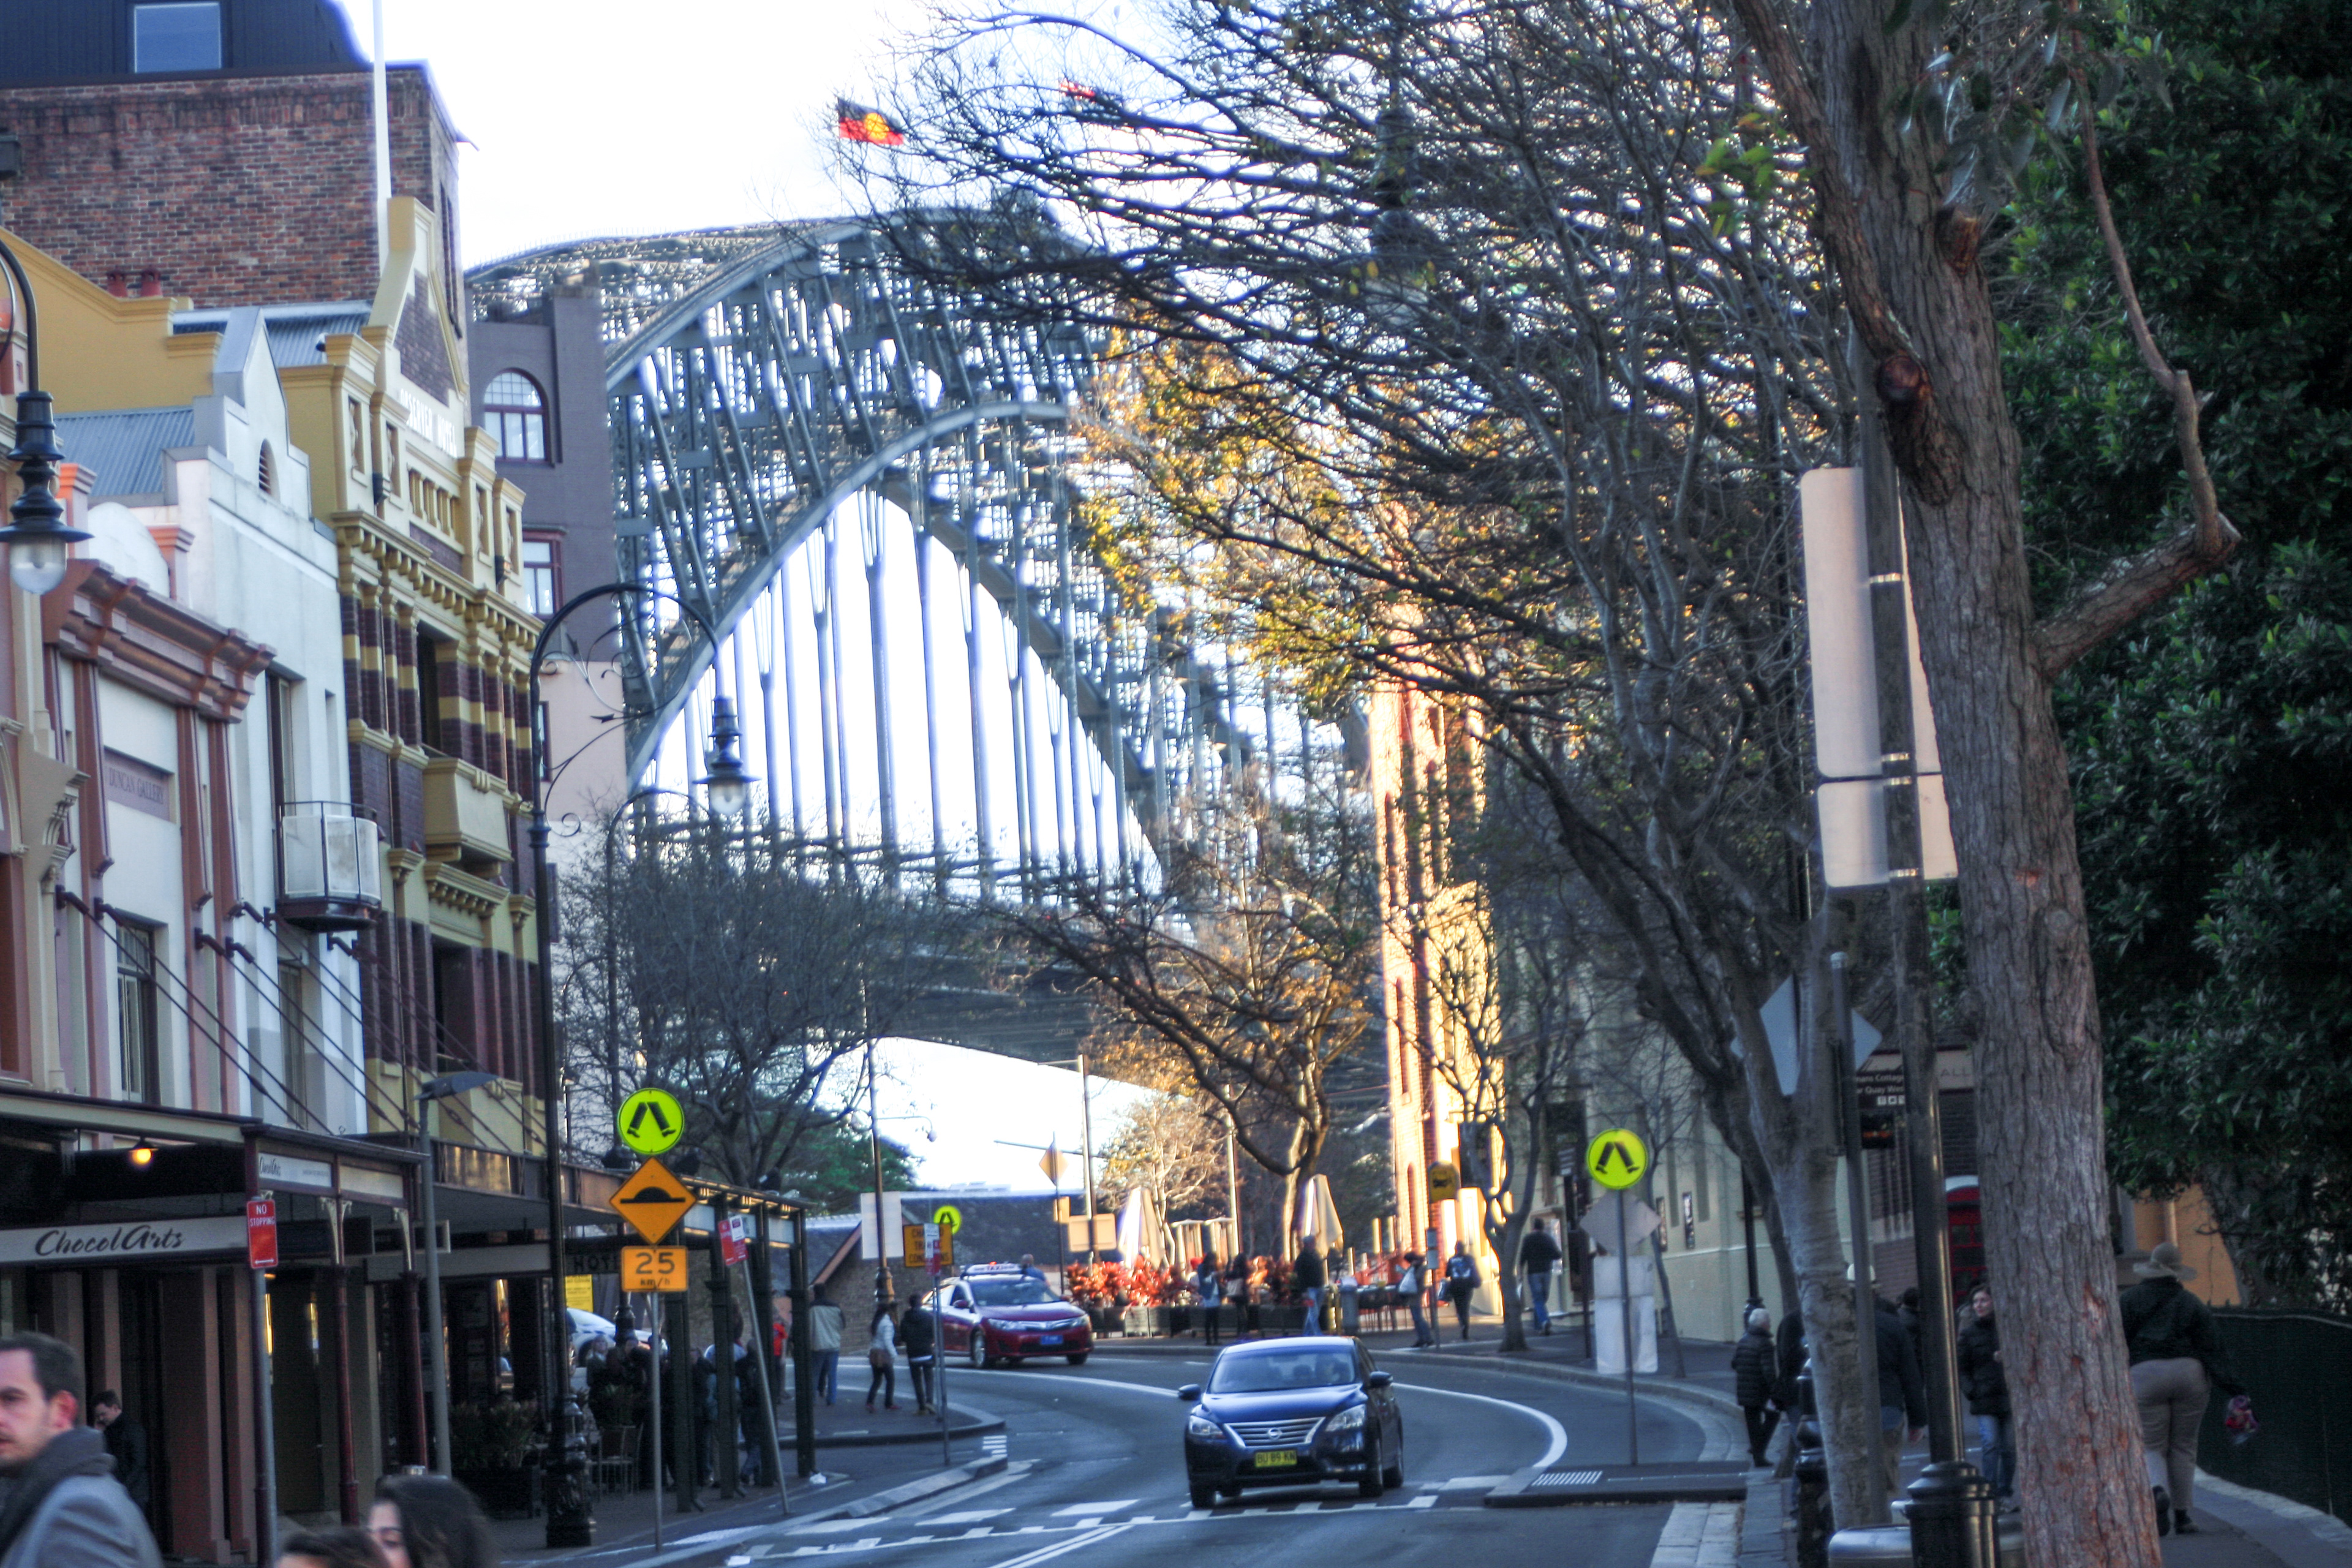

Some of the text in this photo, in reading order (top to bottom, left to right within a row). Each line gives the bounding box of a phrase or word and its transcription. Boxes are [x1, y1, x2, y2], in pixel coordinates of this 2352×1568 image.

[256, 1205, 267, 1215] NO
[249, 1216, 275, 1227] STOPPING
[35, 1225, 184, 1256] ChocolArts
[636, 1252, 675, 1275] 25
[640, 1276, 670, 1287] km/h
